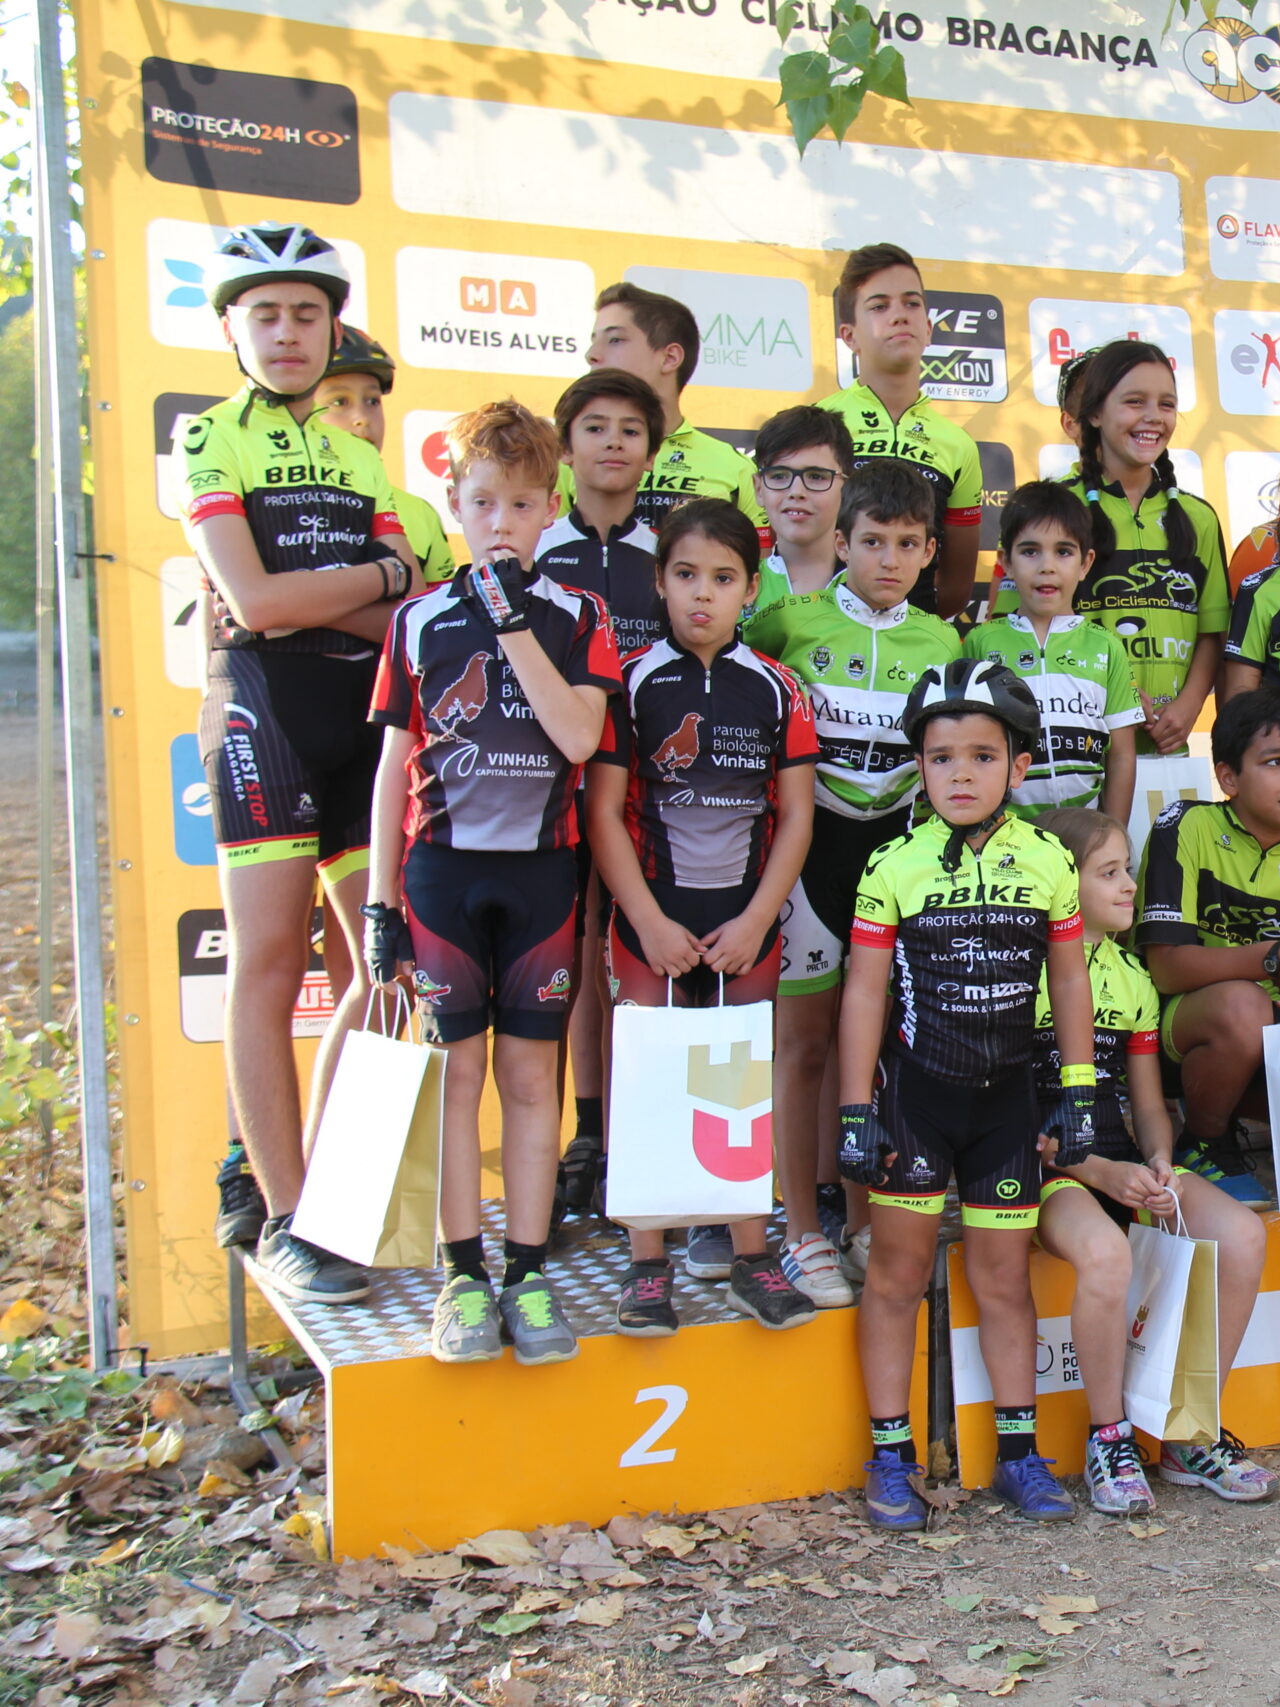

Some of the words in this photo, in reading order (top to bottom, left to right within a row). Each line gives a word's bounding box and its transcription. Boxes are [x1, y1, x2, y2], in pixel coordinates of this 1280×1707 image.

[946, 16, 1158, 71] BRAGANÇA
[151, 105, 300, 144] PROTEÇÃO24H
[212, 140, 263, 155] Segurança
[466, 283, 490, 308] M
[508, 287, 530, 310] A
[420, 321, 503, 347] MÓVEIS
[510, 332, 578, 353] ALVES
[703, 346, 748, 367] BIKE
[926, 386, 943, 396] MY
[946, 387, 990, 398] ENERGY
[265, 465, 354, 487] BBIKE
[1104, 596, 1170, 609] Ciclismo
[713, 726, 761, 740] Parque
[712, 739, 771, 756] Biológico
[487, 753, 550, 768] VINHAIS
[711, 754, 767, 770] Vinhais
[475, 769, 509, 777] CAPITAL
[510, 769, 523, 777] DO
[523, 770, 556, 778] FUMEIRO
[922, 884, 1034, 908] BBIKE
[941, 1002, 949, 1011] Z.
[950, 1004, 979, 1013] SOUSA
[981, 1005, 987, 1013] &
[995, 1211, 1030, 1220] BBIKE
[618, 1384, 689, 1469] 2
